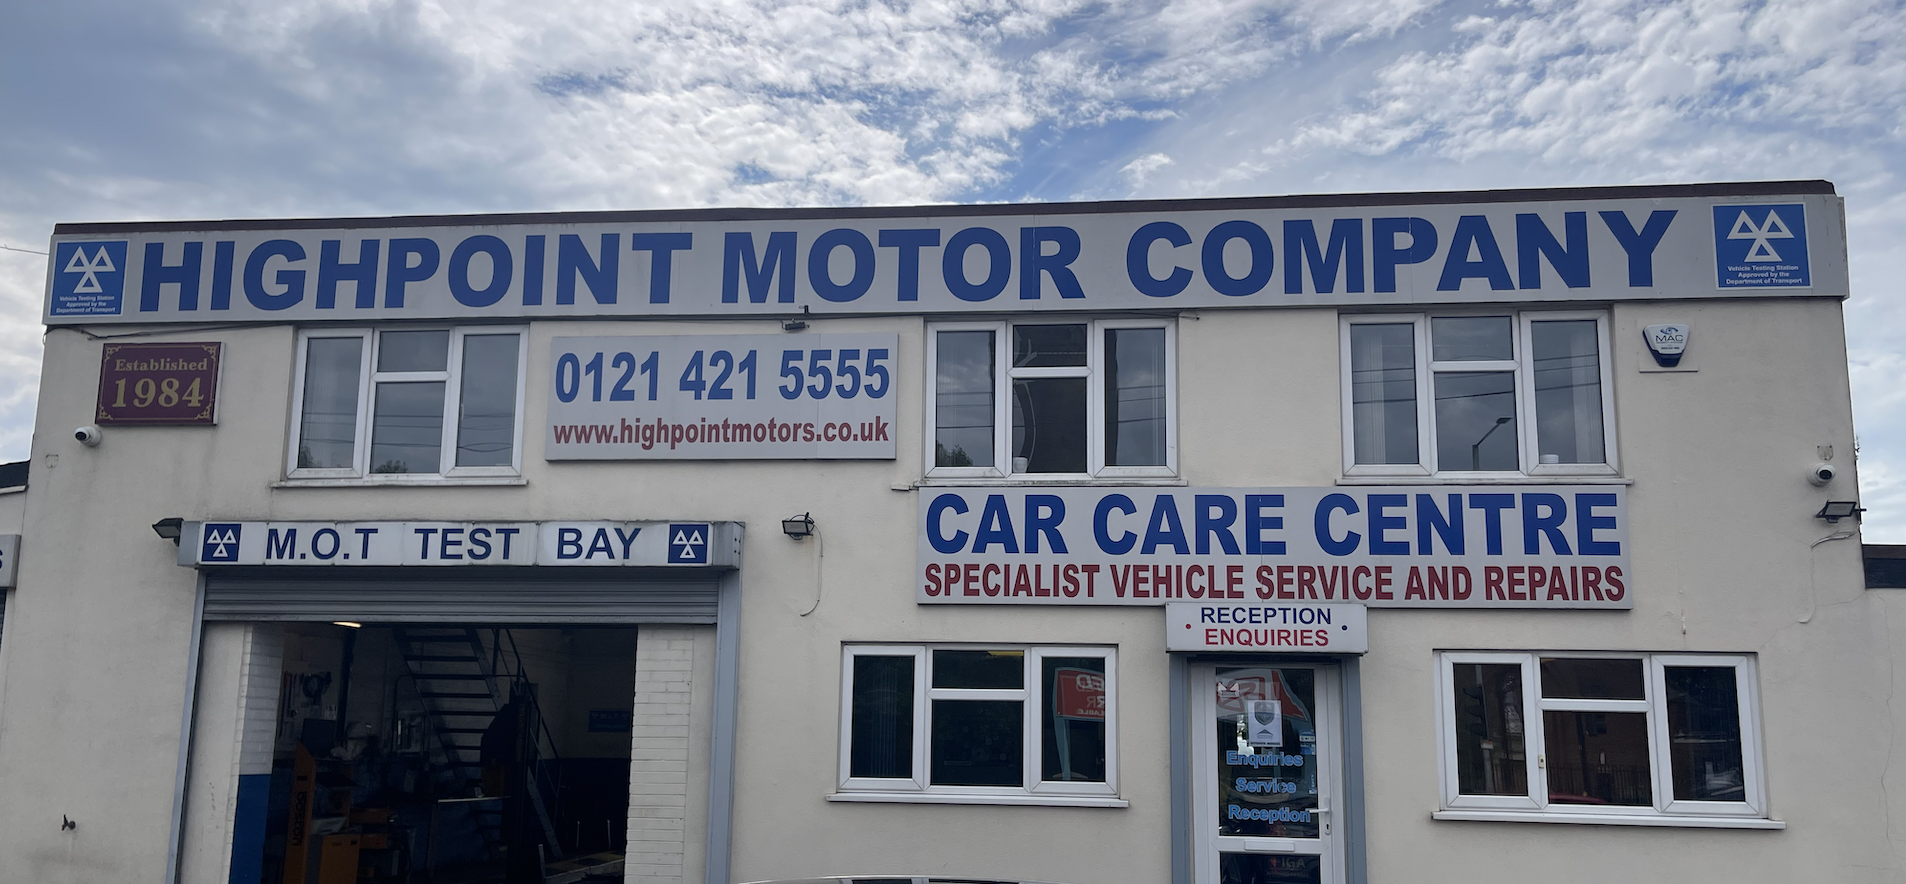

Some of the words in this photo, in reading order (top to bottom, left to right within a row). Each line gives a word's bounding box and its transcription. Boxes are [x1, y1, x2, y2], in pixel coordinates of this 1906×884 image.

[140, 232, 692, 312] HIGHPOINT
[721, 226, 1085, 304] MOTOR
[1126, 210, 1678, 299] COMPANY
[114, 358, 208, 371] Established
[555, 351, 659, 403] 0121
[679, 350, 757, 400] 421
[778, 348, 890, 400] 5555
[112, 377, 204, 408] 1984
[553, 416, 889, 450] www.highpointmotors.co.uk
[926, 493, 1068, 554] CAR
[1093, 493, 1287, 555] CARE
[1314, 493, 1621, 556] CENTRE
[266, 528, 378, 560] M.O.T
[415, 528, 520, 560] TEST
[556, 527, 642, 560] BAY
[925, 563, 1100, 598] SPECIALIST
[1109, 564, 1244, 599] VEHICLE
[1255, 565, 1393, 600] SERVICE
[1404, 566, 1472, 600] AND
[1484, 566, 1625, 601] REPAIRS
[1201, 607, 1331, 624] RECEPTION
[1205, 628, 1329, 647] ENQUIRIES
[1226, 750, 1304, 769] Enquiries
[1235, 777, 1297, 794] Service
[1228, 804, 1311, 824] Reception
